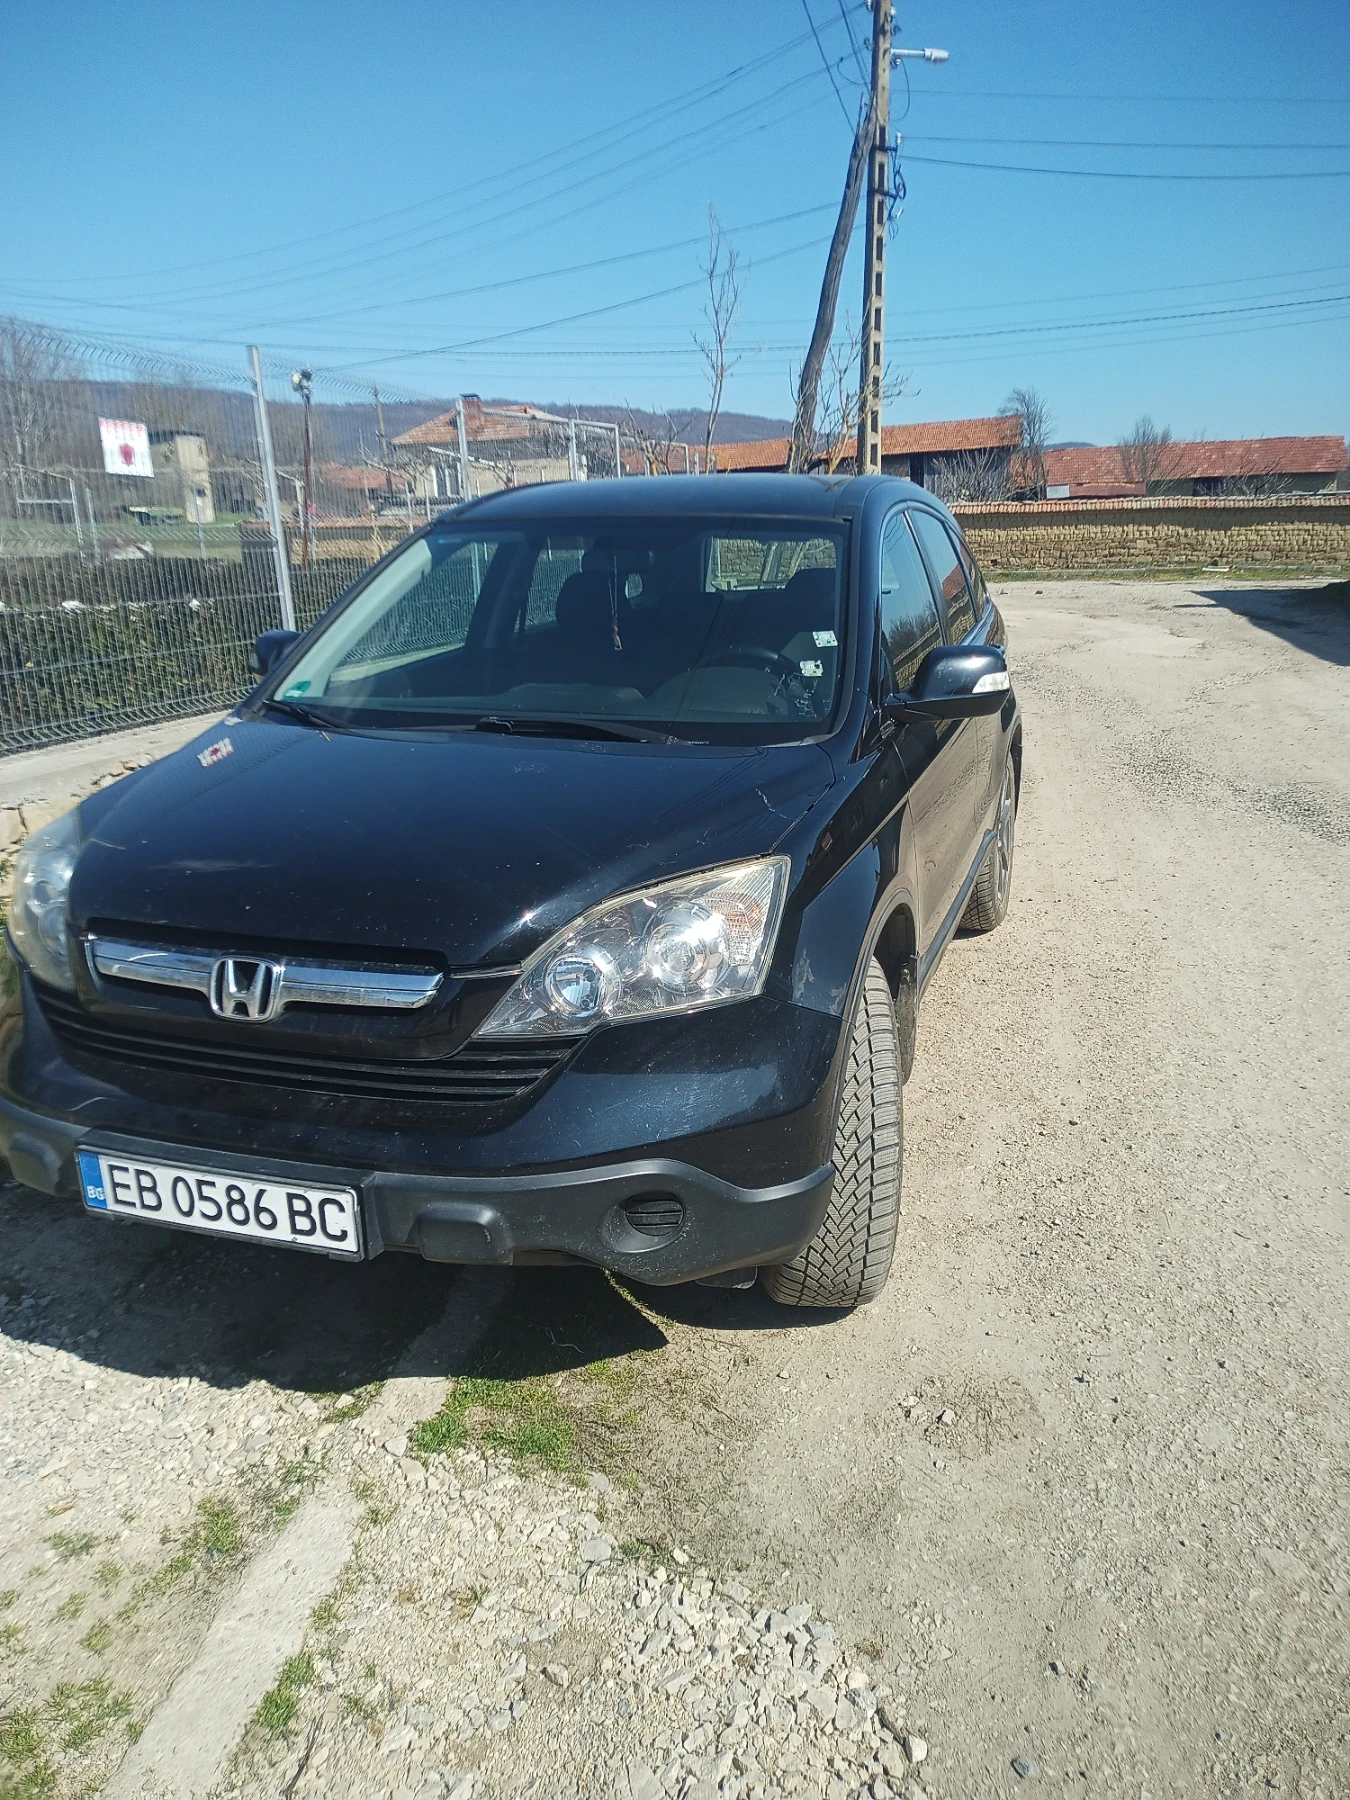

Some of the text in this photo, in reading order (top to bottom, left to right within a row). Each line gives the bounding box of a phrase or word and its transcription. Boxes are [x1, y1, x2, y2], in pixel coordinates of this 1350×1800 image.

[86, 1185, 105, 1201] BG
[108, 1163, 348, 1242] EB 0586 BC
